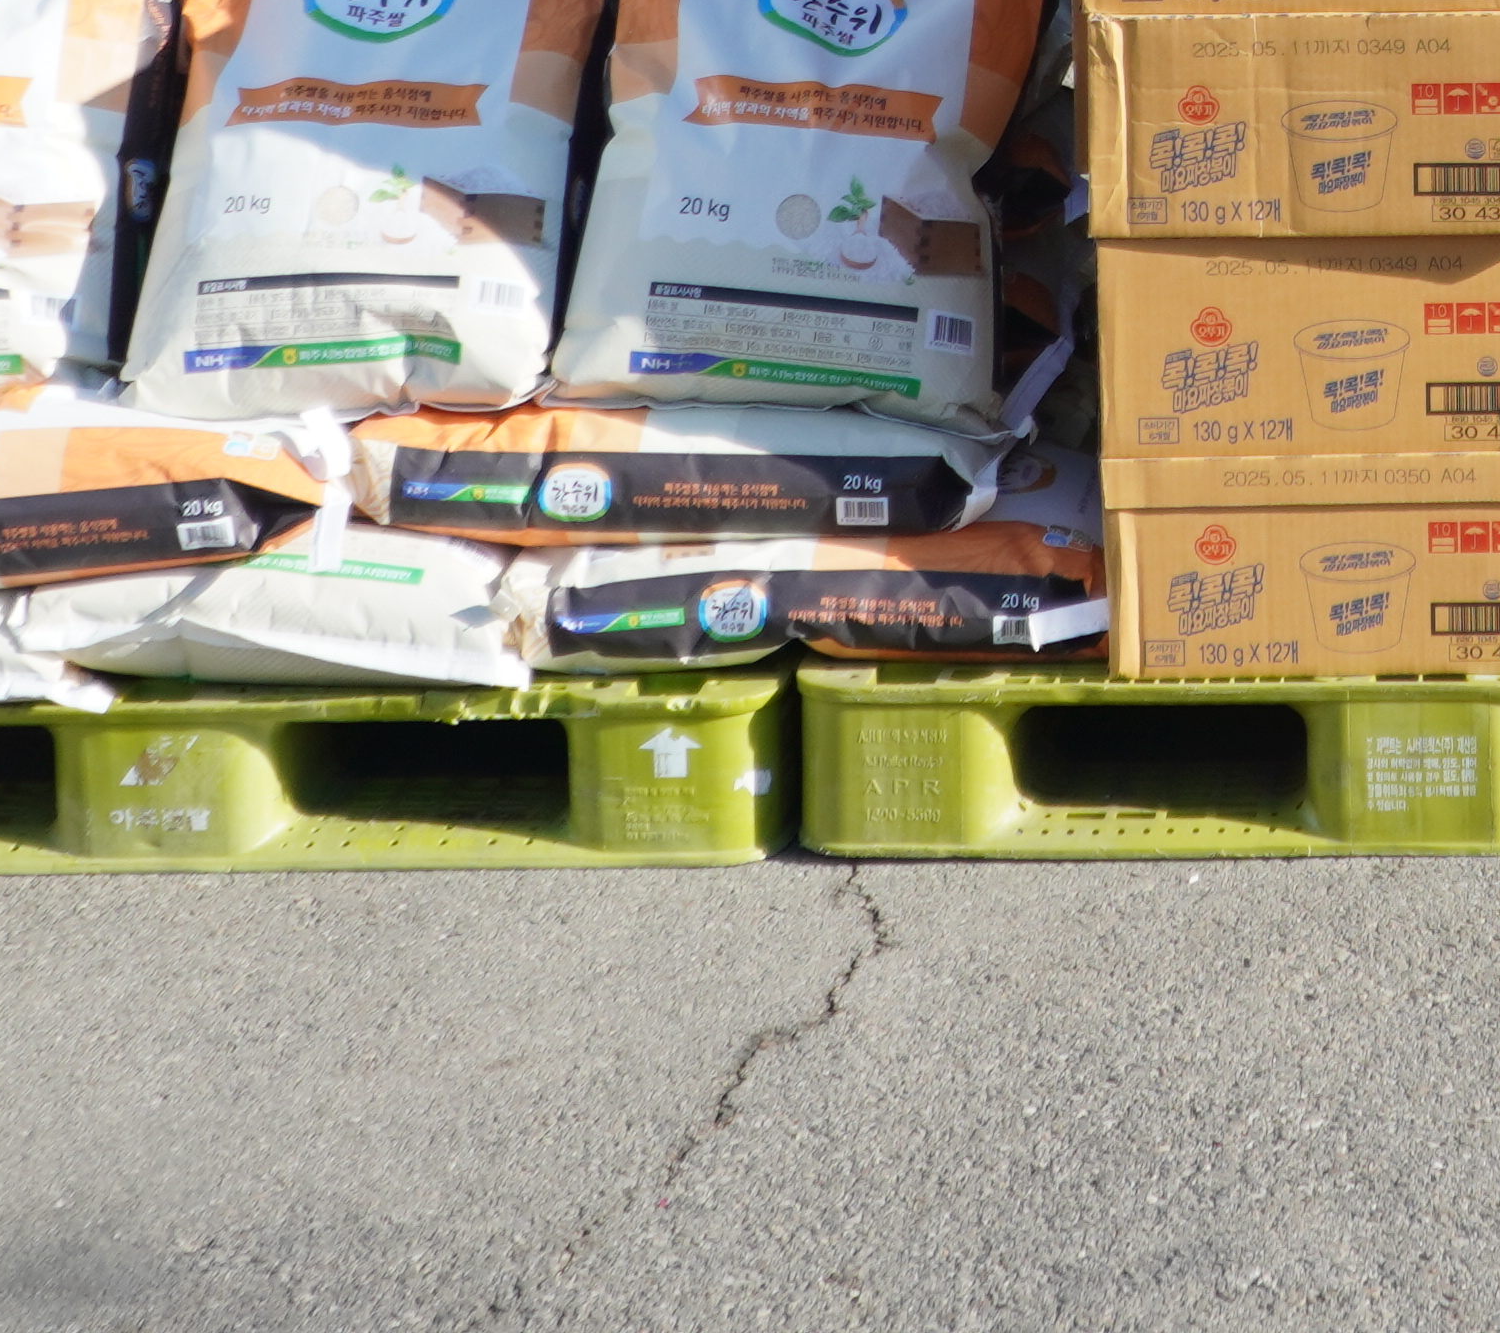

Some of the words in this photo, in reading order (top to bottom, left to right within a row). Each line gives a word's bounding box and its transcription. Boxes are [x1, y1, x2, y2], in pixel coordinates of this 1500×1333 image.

[347, 5, 407, 28] 파주쌀
[224, 195, 244, 214] 20
[248, 193, 271, 217] kg
[679, 196, 702, 217] 20
[706, 198, 730, 223] kg
[843, 475, 861, 491] 20
[864, 474, 882, 493] kg
[1001, 593, 1018, 610] 20
[1021, 593, 1040, 612] kg
